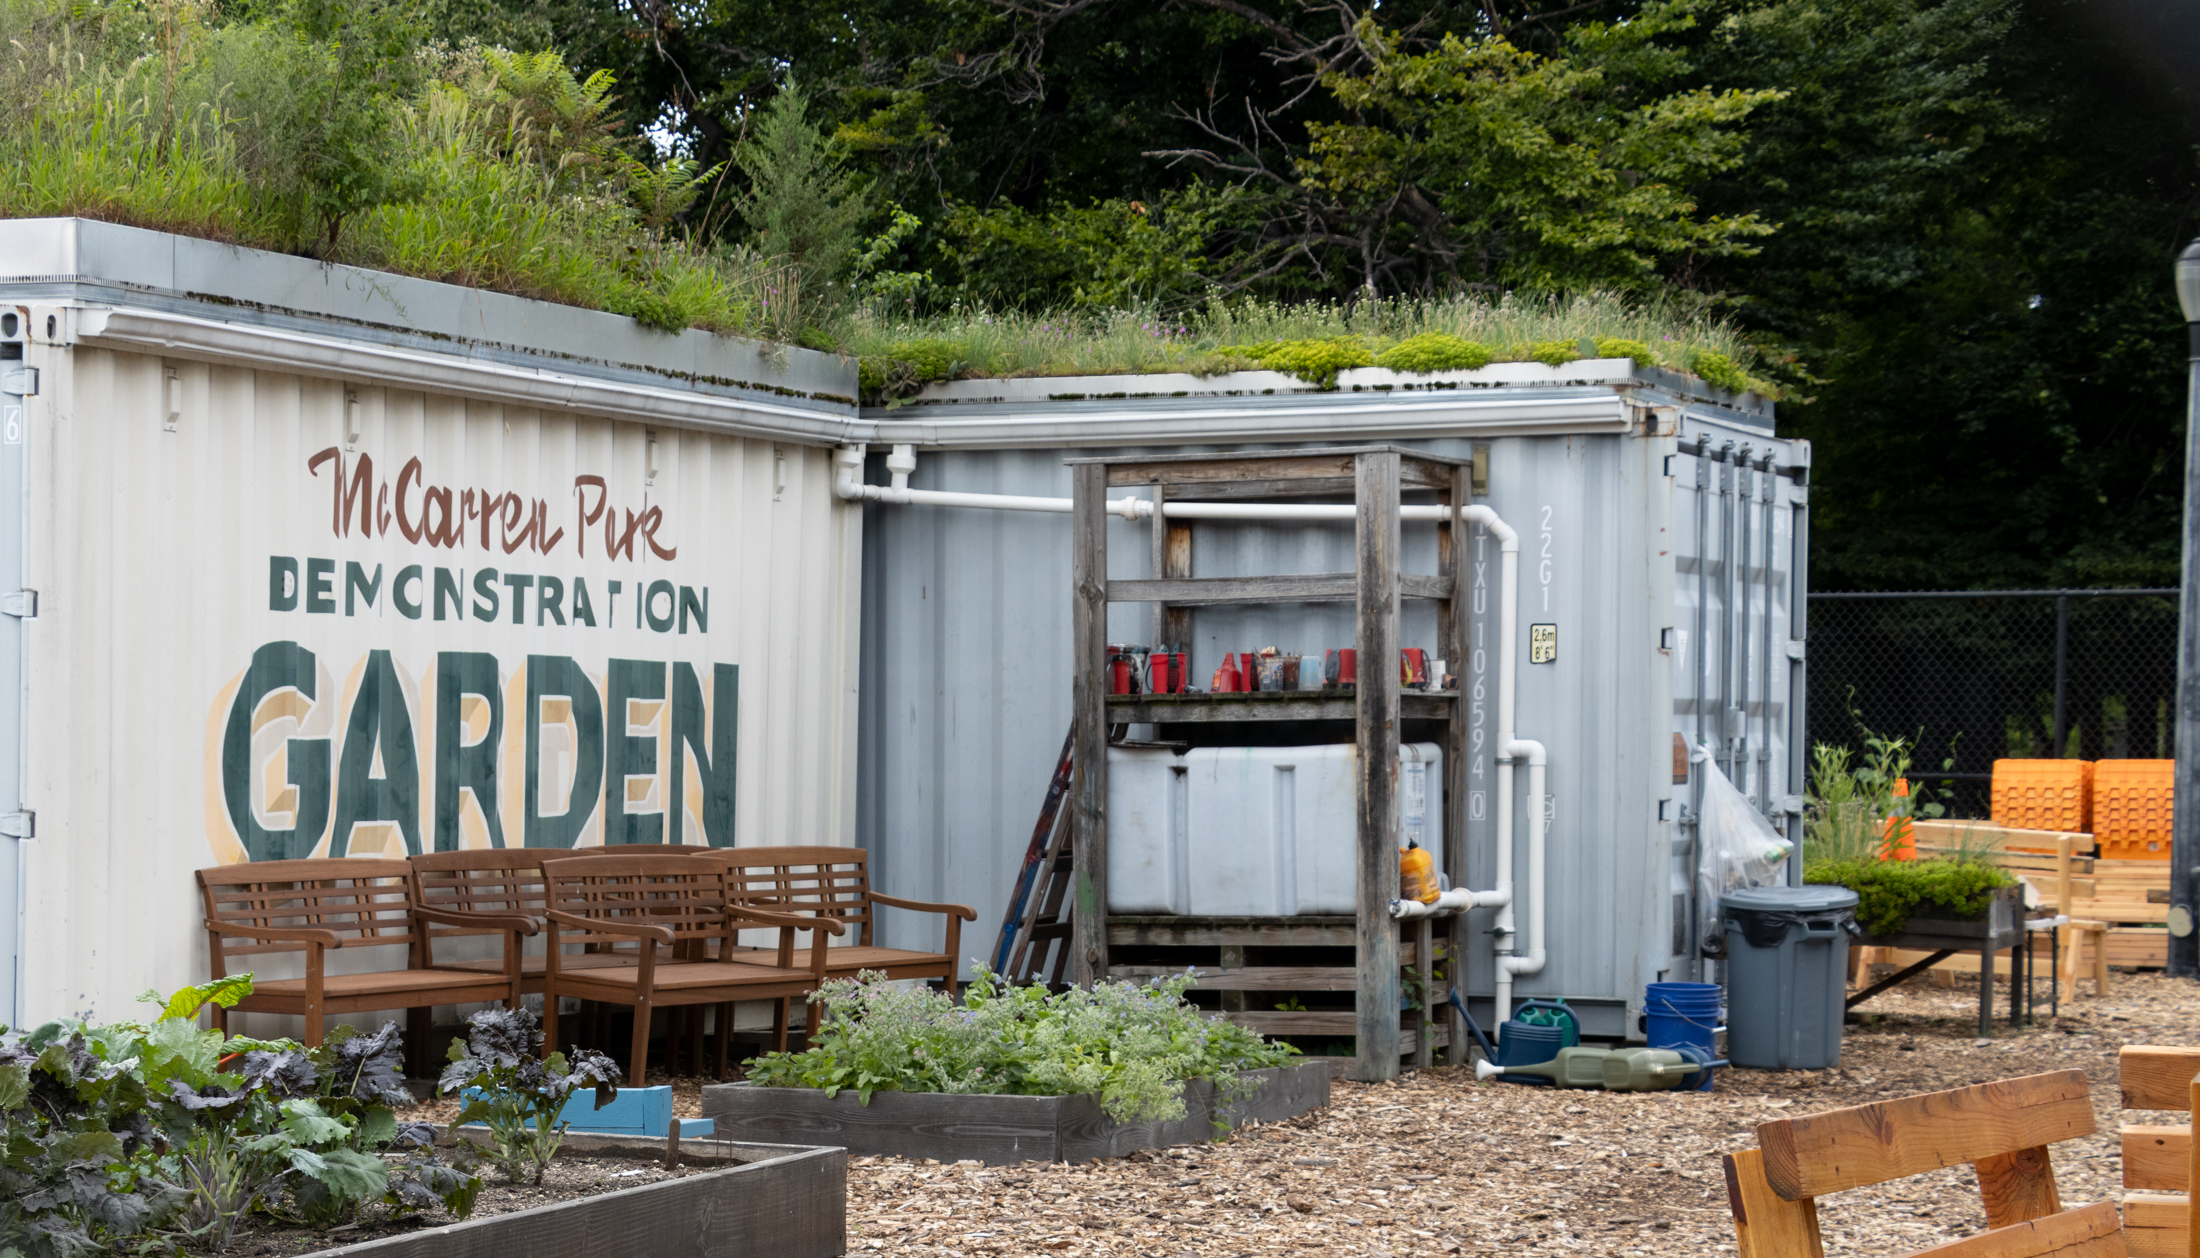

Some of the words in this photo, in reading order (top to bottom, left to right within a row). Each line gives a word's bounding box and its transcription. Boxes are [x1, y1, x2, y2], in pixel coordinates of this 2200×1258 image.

[6, 408, 19, 442] 6
[307, 446, 565, 557] McCarren
[268, 555, 709, 635] DEMONSTRATION
[1539, 505, 1553, 612] 22G1
[218, 640, 741, 863] GARDEN
[1472, 622, 1486, 780] 106594
